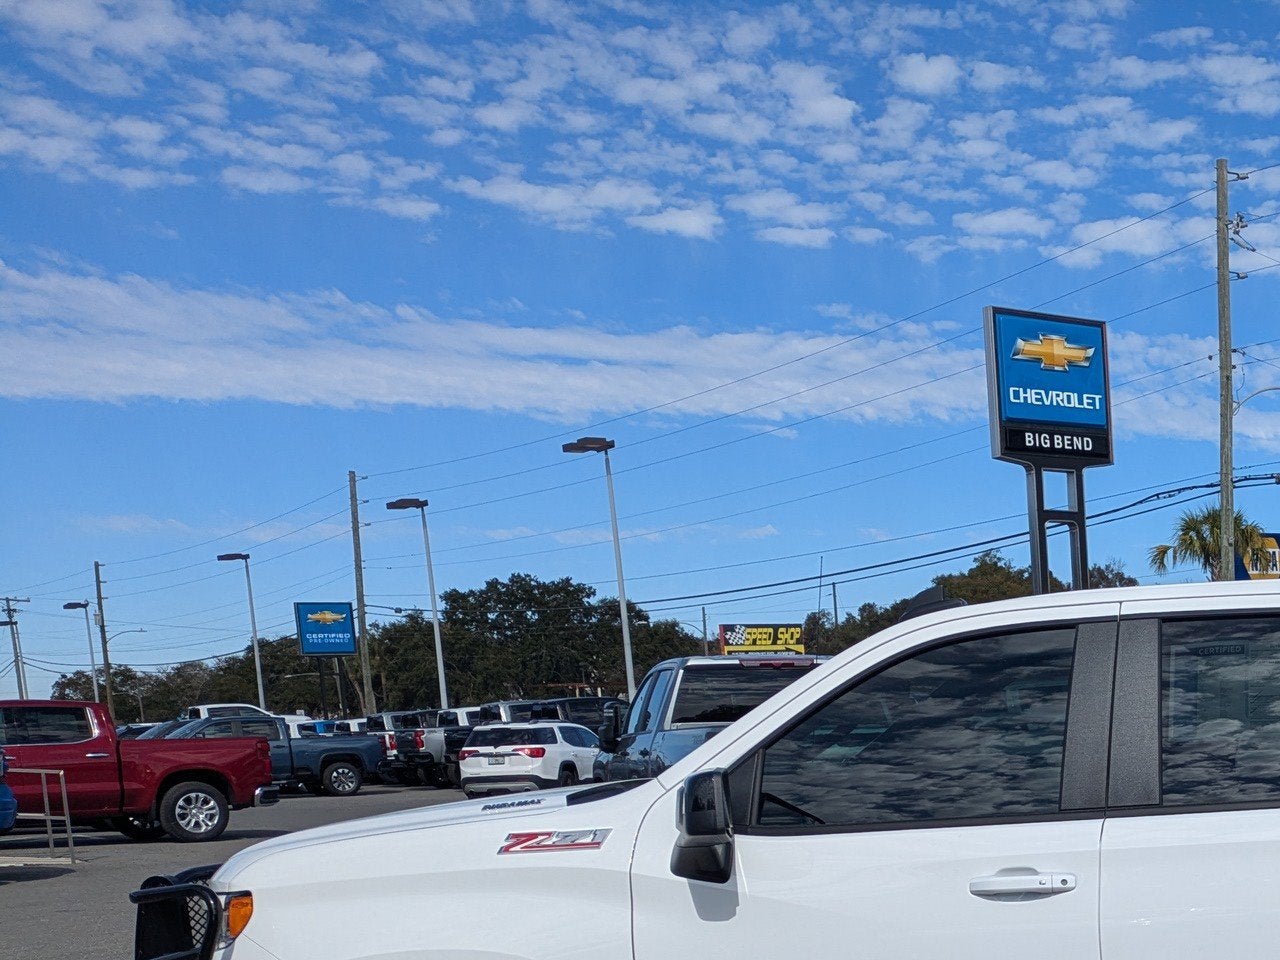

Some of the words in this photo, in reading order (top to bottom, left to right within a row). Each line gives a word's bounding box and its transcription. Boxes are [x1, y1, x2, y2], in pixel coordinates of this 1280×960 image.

[1009, 387, 1102, 410] CHEVROLET
[1025, 432, 1050, 448] BIG
[1054, 435, 1093, 451] BEND
[744, 627, 774, 645] SPEED
[777, 627, 801, 645] SHOP
[1199, 646, 1242, 656] CERTIFIED
[497, 827, 613, 855] Z71
